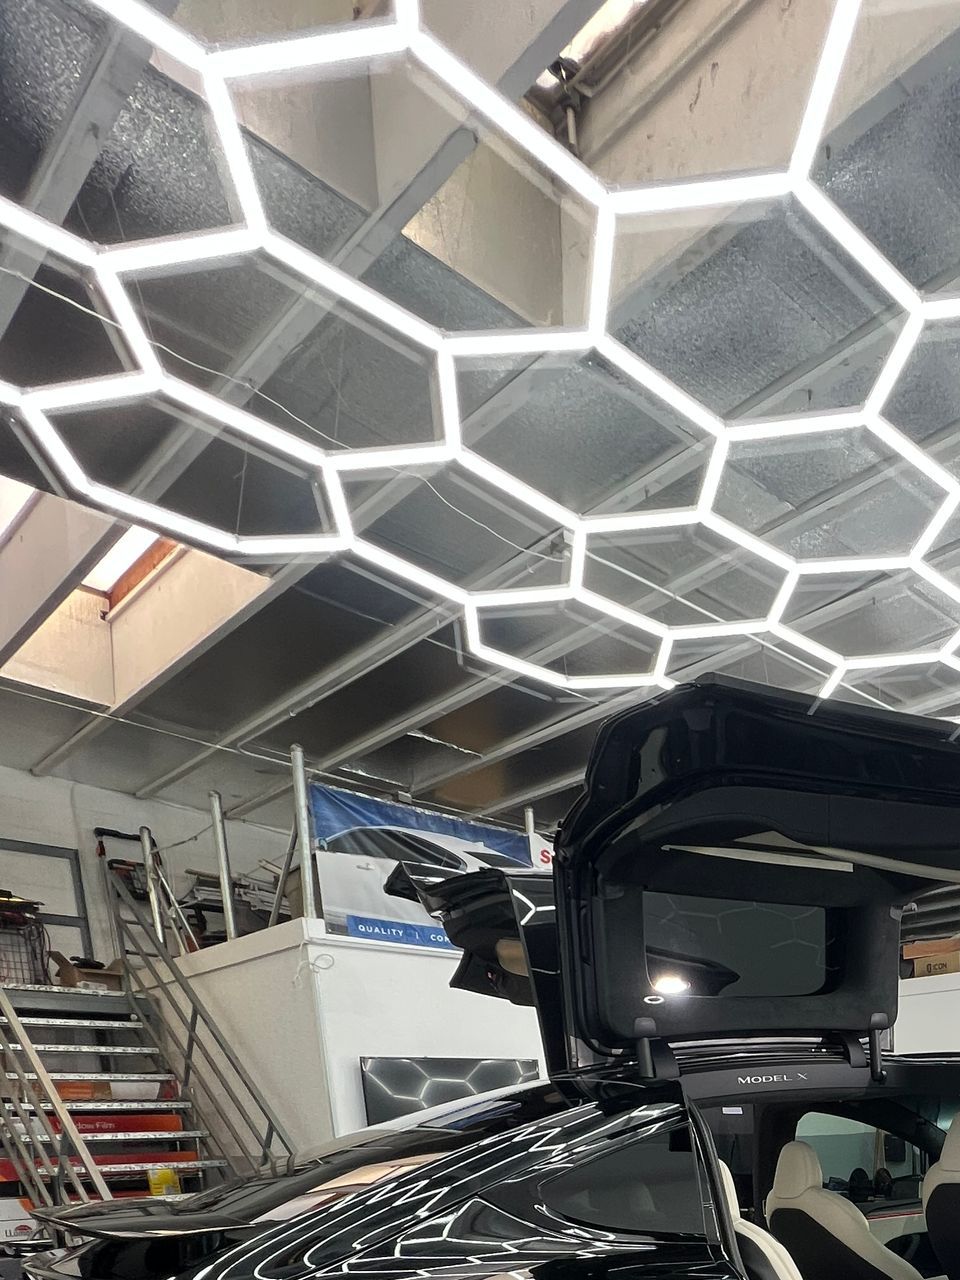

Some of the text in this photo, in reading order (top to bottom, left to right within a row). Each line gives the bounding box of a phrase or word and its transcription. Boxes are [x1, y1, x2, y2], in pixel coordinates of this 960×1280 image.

[358, 924, 404, 937] QUALITY
[737, 1073, 808, 1085] MODEL X
